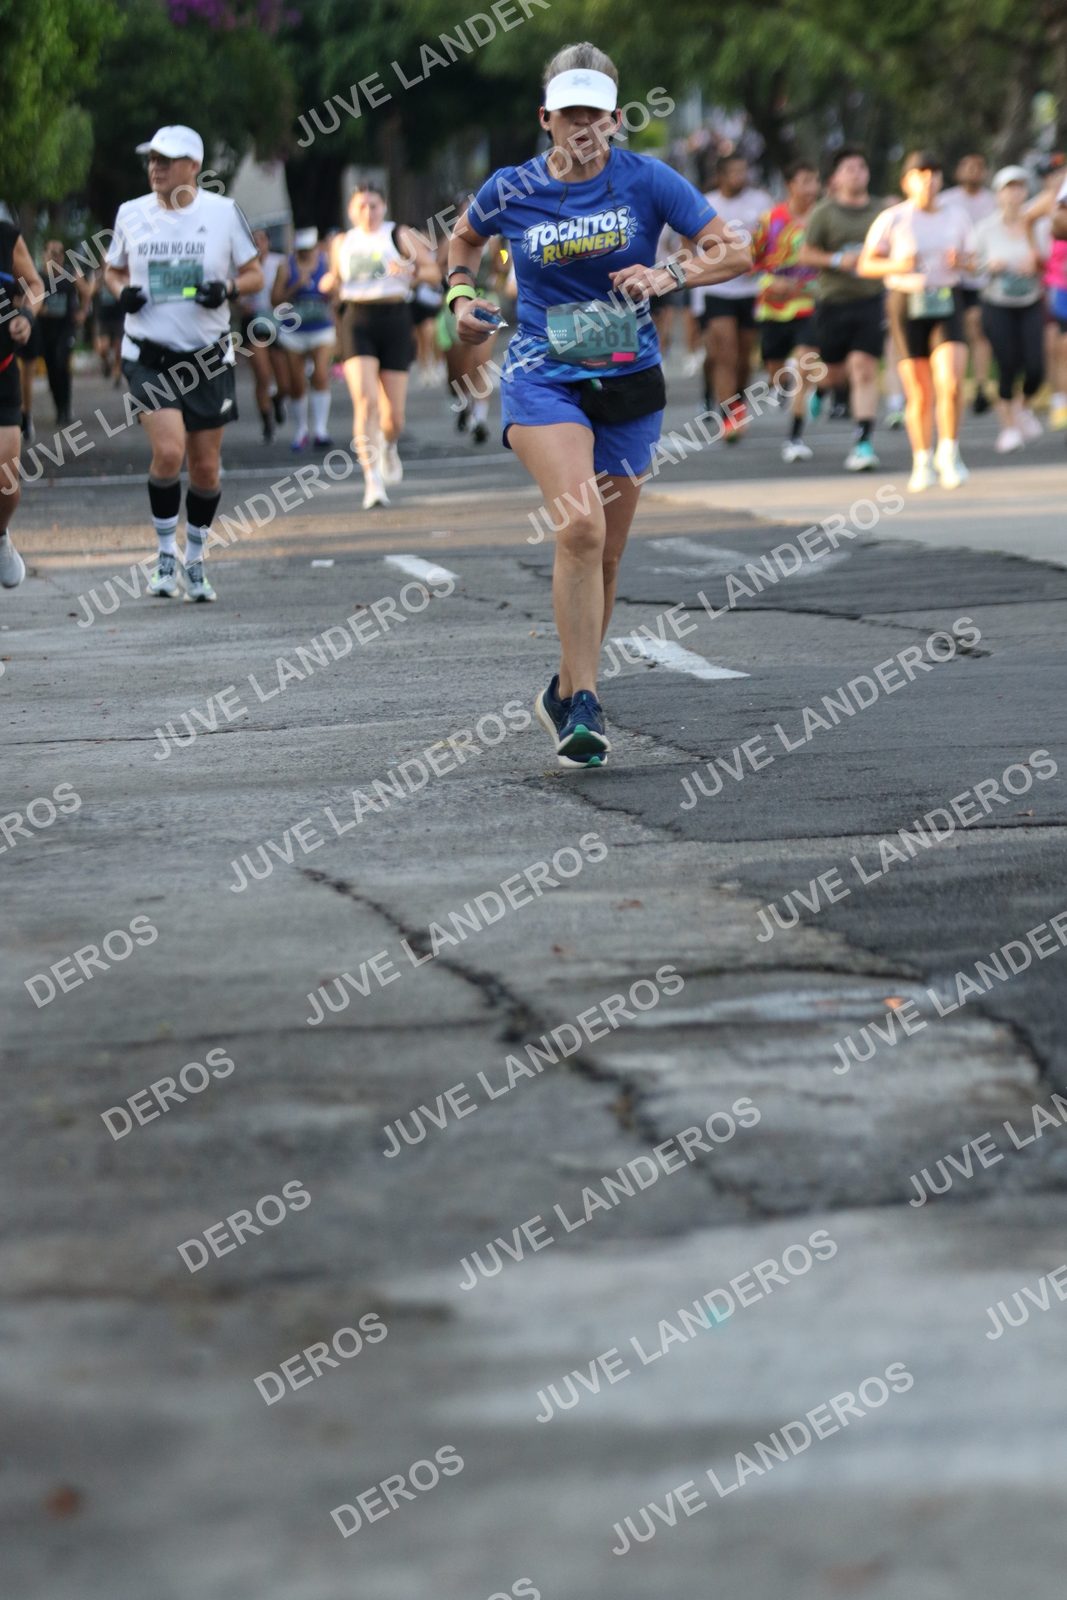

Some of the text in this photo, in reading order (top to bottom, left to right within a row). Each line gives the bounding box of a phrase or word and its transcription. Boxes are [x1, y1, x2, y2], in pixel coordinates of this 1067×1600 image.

[528, 208, 629, 254] TOCHITOS
[138, 241, 205, 255] NO PAIN NO GAIN
